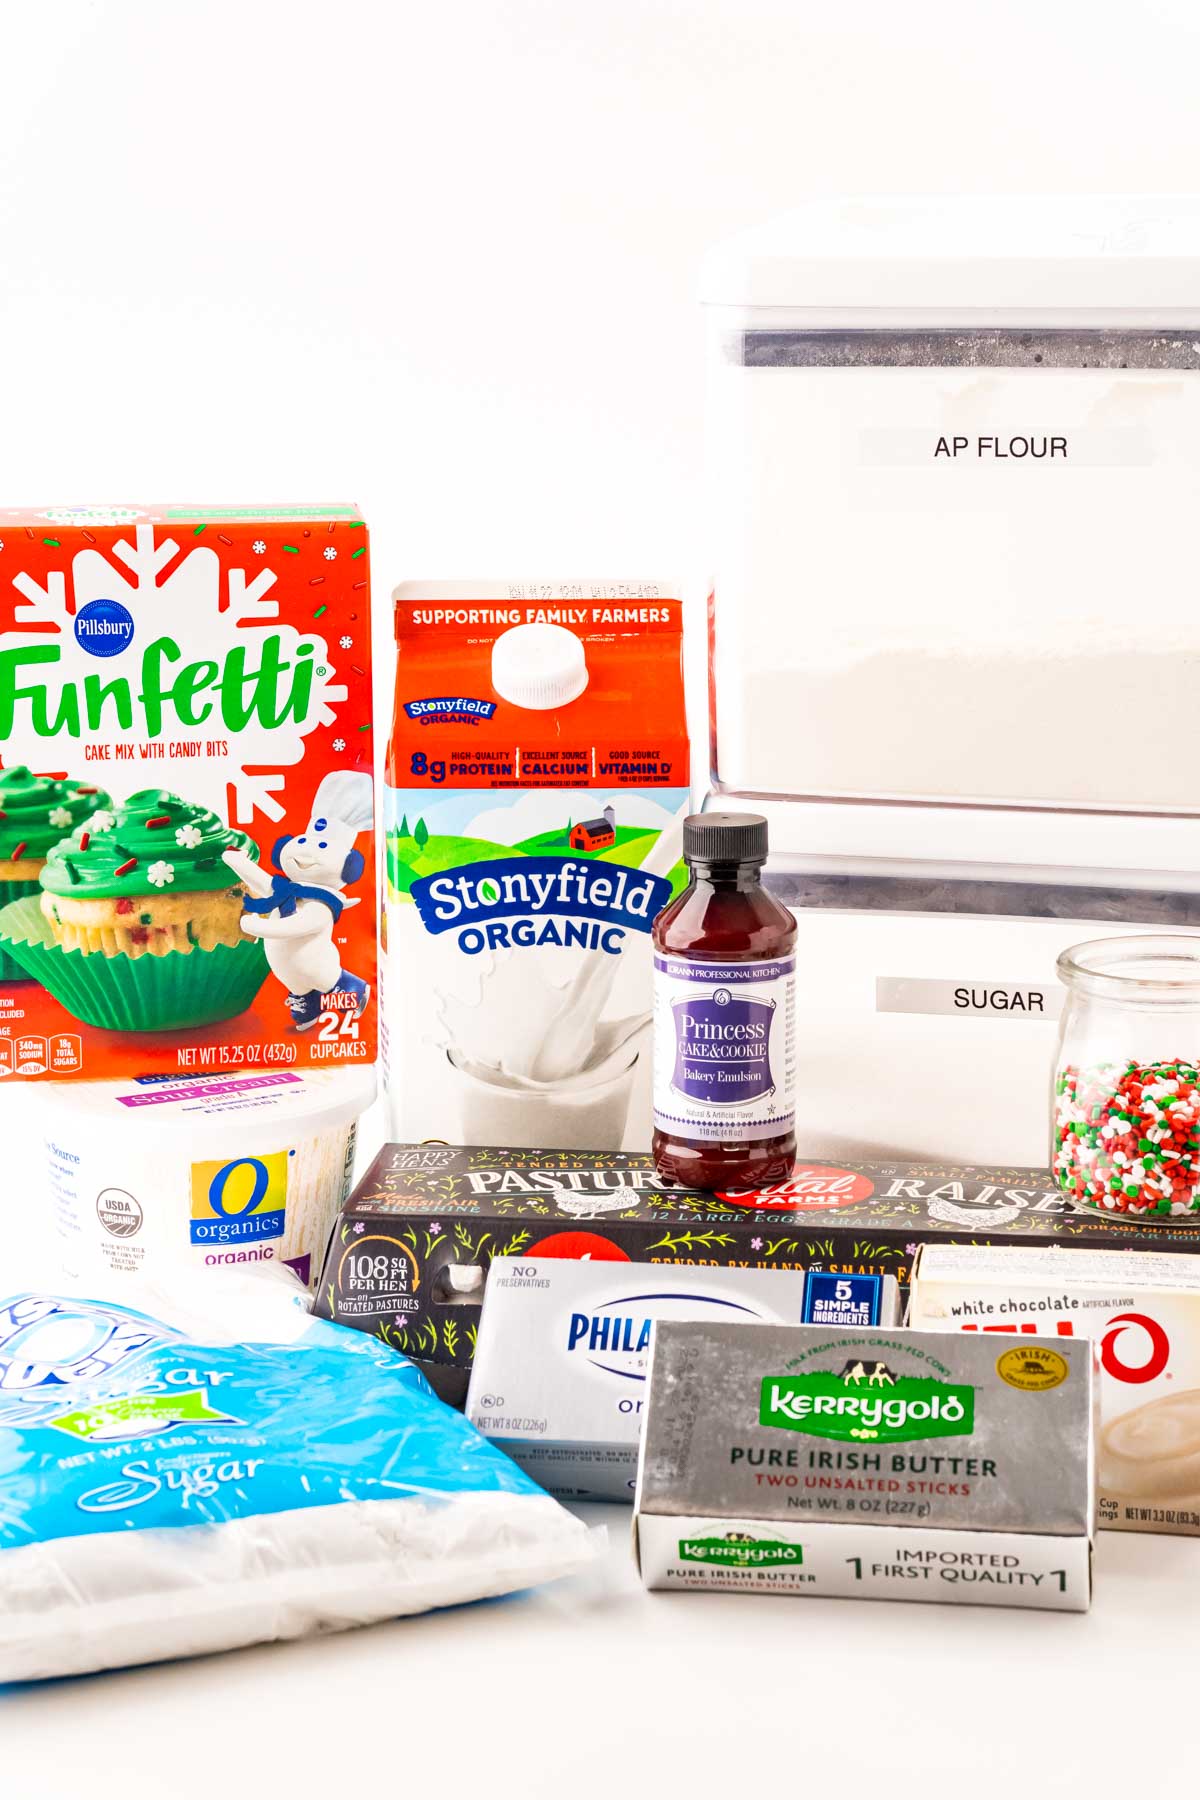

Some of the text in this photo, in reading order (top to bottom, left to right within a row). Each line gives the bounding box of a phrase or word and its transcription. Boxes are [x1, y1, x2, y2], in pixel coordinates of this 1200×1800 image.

[934, 437, 1068, 458] AP FLOUR
[412, 608, 670, 625] SUPPORTING FAMILY FARMERS
[77, 618, 132, 639] Pillsbury
[0, 634, 315, 741] Funfetti
[409, 698, 491, 715] Stonyfield
[420, 714, 481, 726] ORGANIC
[85, 740, 229, 761] CAKE MIX WITH CANDY BITS
[451, 752, 510, 760] HIGH-QUALITY
[522, 751, 587, 760] EXCELLENT SOURCE
[609, 751, 660, 760] GOOD SOURCE
[410, 752, 446, 783] 8g
[450, 763, 512, 775] PROTEIN
[522, 763, 588, 775] CALCIUM
[599, 763, 658, 775] VITAMIN
[428, 862, 656, 920] Stonyfield
[457, 918, 626, 955] ORGANIC
[696, 969, 751, 979] PROFESSIONAL
[753, 967, 780, 977] KITCHEN
[320, 993, 358, 1010] MAKES
[954, 988, 1044, 1012] SUGAR
[318, 1010, 359, 1041] 24
[681, 1014, 765, 1041] Princess
[19, 1041, 43, 1051] 340mg
[57, 1049, 74, 1057] TOTAL
[310, 1041, 367, 1059] CUPCAKES
[679, 1042, 767, 1059] CAKE&COOKIE
[19, 1051, 43, 1059] SODIUM
[54, 1058, 77, 1066] SUGARS
[177, 1043, 297, 1066] NET WT 15.25 OZ (432g)
[684, 1067, 762, 1083] Bakery Emulsion
[130, 1090, 196, 1106] Sour
[201, 1076, 289, 1094] Cream
[391, 1151, 464, 1161] HAPPY
[391, 1159, 449, 1169] HENS
[501, 1161, 584, 1169] TENDED
[105, 1200, 131, 1212] USDA
[755, 1195, 841, 1205] FARMS
[377, 1205, 481, 1213] SUNSHINE
[103, 1213, 136, 1225] ORGANIC
[650, 1211, 669, 1220] 12
[677, 1212, 745, 1222] LARGE
[754, 1214, 807, 1224] EGGS
[822, 1216, 892, 1227] GRADE
[196, 1217, 279, 1242] organics
[348, 1255, 388, 1280] 108
[391, 1258, 408, 1269] SQ
[512, 1266, 537, 1277] NO
[391, 1270, 408, 1280] FT
[350, 1280, 407, 1291] PER HEN
[497, 1278, 551, 1289] PRESERVATIVES
[835, 1280, 852, 1301] 5
[338, 1299, 420, 1313] ROTATED PASTURES
[814, 1299, 870, 1314] SIMPLE
[952, 1300, 994, 1317] white
[1000, 1294, 1079, 1313] chocolate
[812, 1310, 869, 1326] INGREDIENTS
[807, 1341, 835, 1357] FROM
[837, 1338, 866, 1347] IRISH
[1014, 1350, 1051, 1362] IRISH
[477, 1416, 547, 1434] NET WT 8 OZ (226g)
[57, 1453, 98, 1469] NET
[100, 1443, 138, 1460] WT.
[140, 1442, 155, 1452] 2
[730, 1447, 998, 1478] PURE IRISH BUTTER
[77, 1458, 265, 1512] Sugar
[754, 1473, 971, 1496] TWO UNSALTED STICKS
[787, 1496, 813, 1510] Net
[846, 1500, 854, 1512] 8
[859, 1500, 881, 1513] OZ
[1099, 1498, 1119, 1510] Cup
[1125, 1507, 1139, 1519] NET
[1140, 1508, 1151, 1520] WT
[1165, 1510, 1175, 1523] OZ
[896, 1549, 1020, 1569] IMPORTED
[667, 1569, 816, 1583] PURE IRISH BUTTER
[846, 1557, 863, 1580] 1
[871, 1564, 1044, 1586] FIRST QUALITY
[1049, 1569, 1067, 1593] 1
